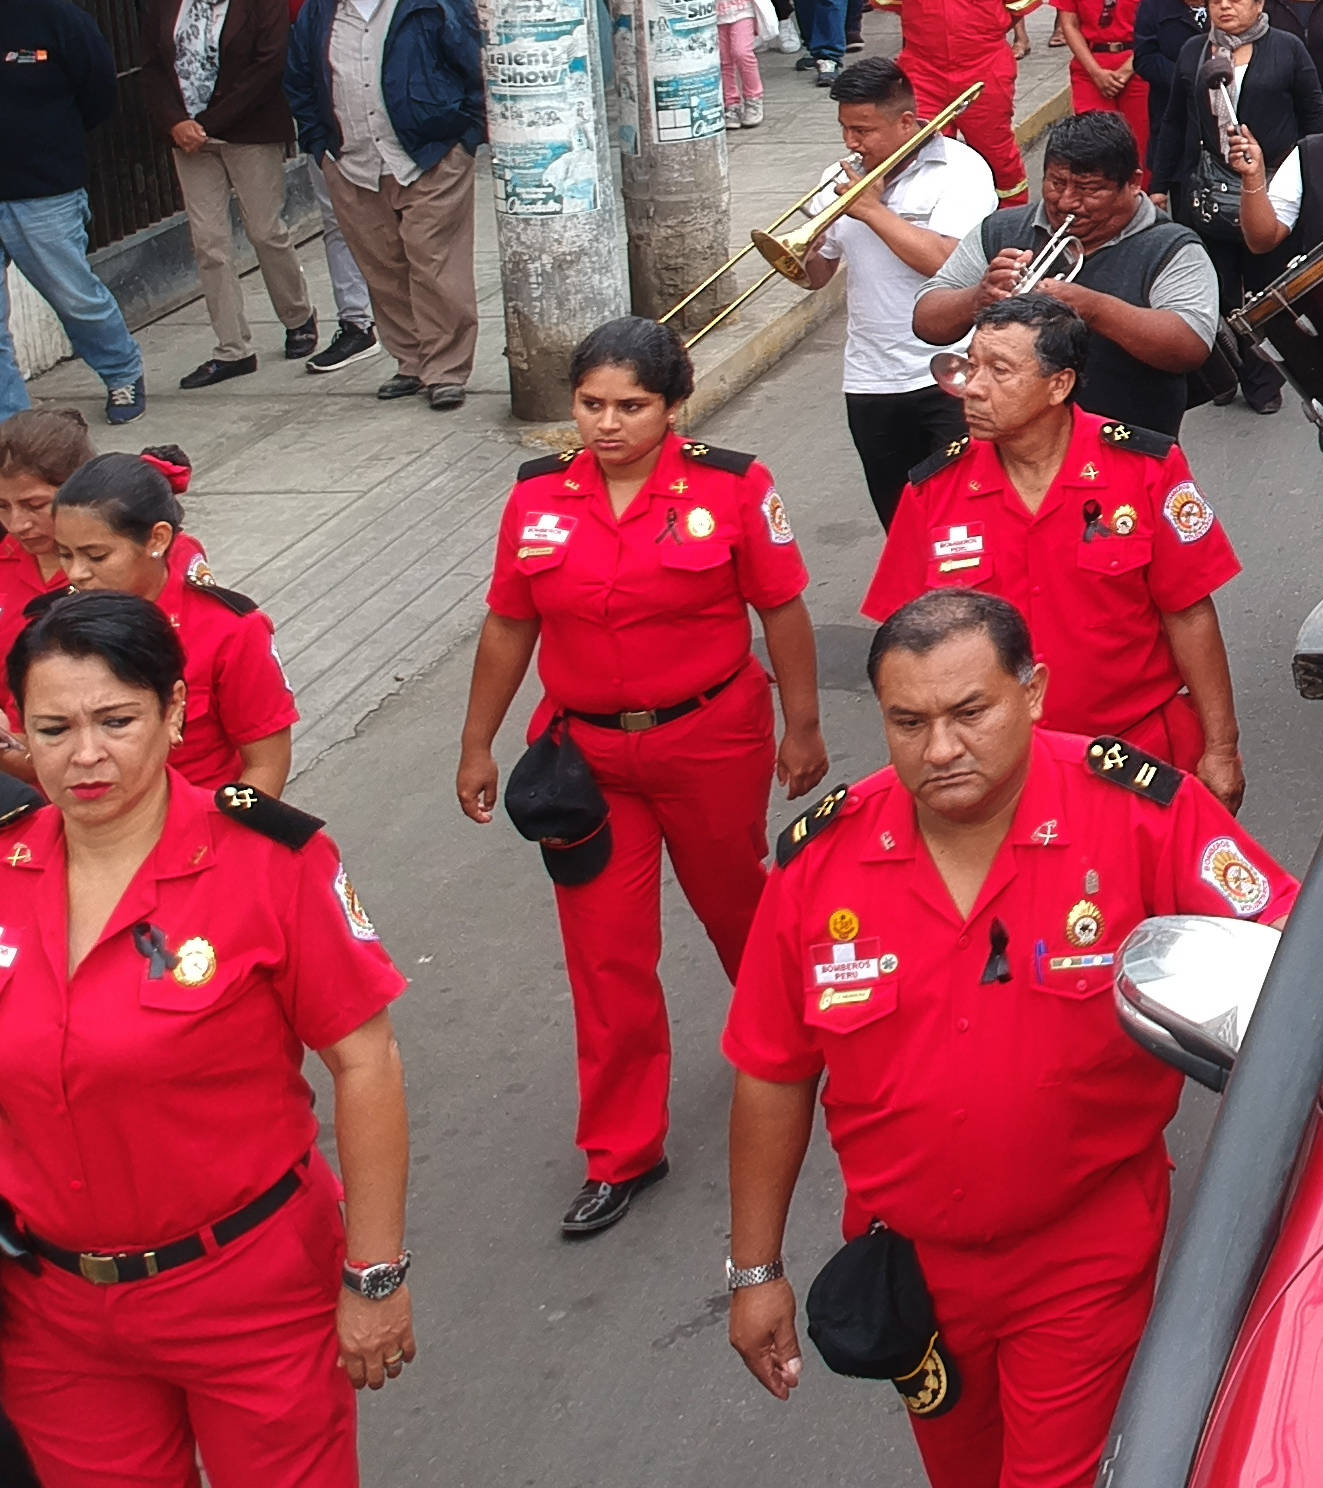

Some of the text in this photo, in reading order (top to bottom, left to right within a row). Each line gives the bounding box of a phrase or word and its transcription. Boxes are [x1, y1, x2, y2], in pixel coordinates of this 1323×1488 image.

[500, 67, 560, 85] Show
[821, 961, 870, 973] BOMBEROS
[834, 971, 858, 980] PERU
